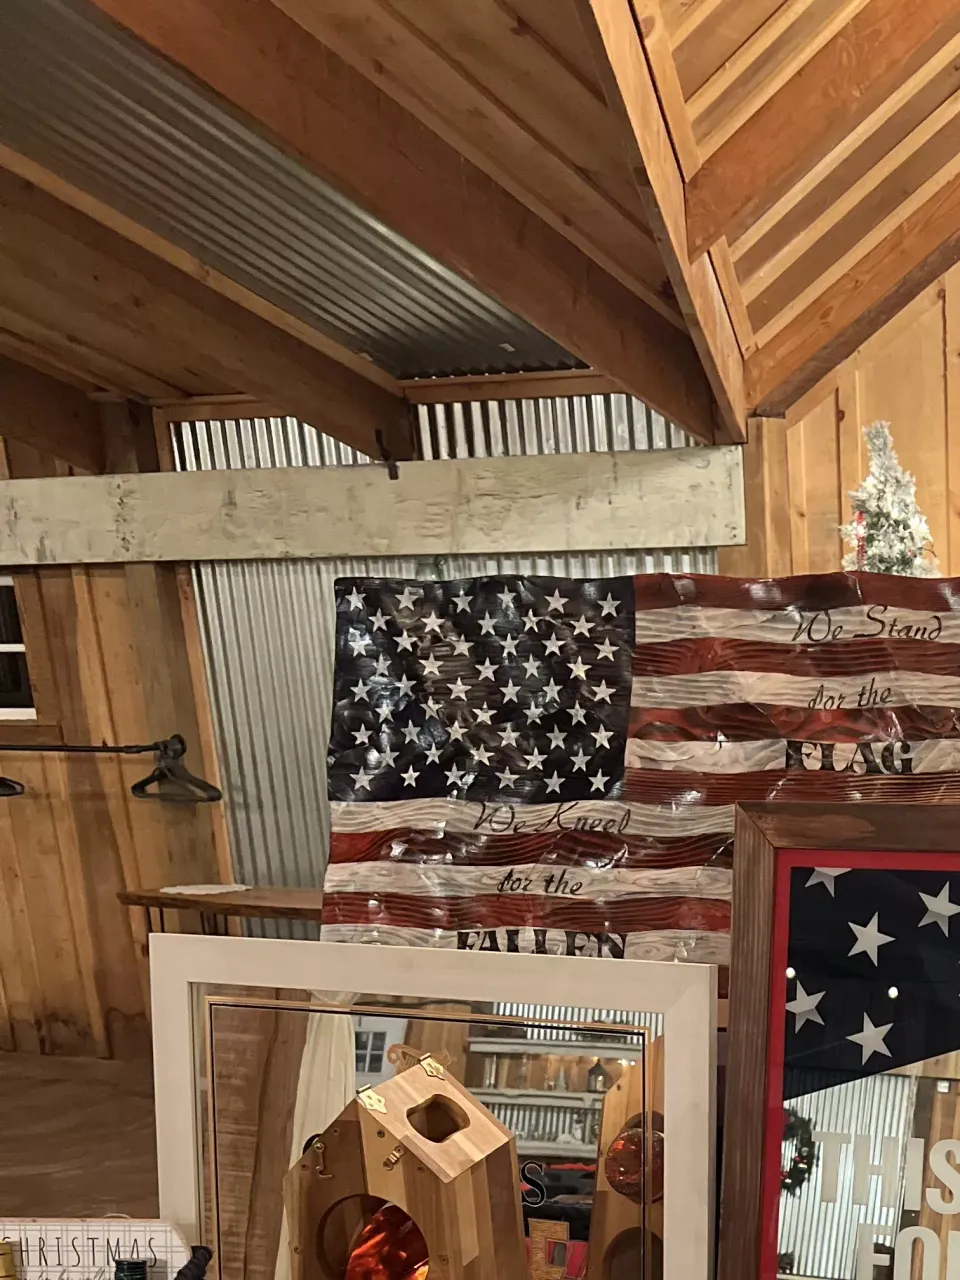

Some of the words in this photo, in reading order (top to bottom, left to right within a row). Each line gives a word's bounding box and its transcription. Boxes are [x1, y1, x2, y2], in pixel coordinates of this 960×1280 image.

[790, 608, 843, 642] We
[853, 604, 942, 641] Stand
[808, 684, 846, 709] for
[858, 677, 892, 708] the
[786, 740, 914, 774] FLAG
[468, 801, 526, 833] We
[534, 801, 631, 833] Kneel
[497, 868, 533, 893] for
[544, 868, 583, 895] the
[457, 929, 628, 960] FALLEN
